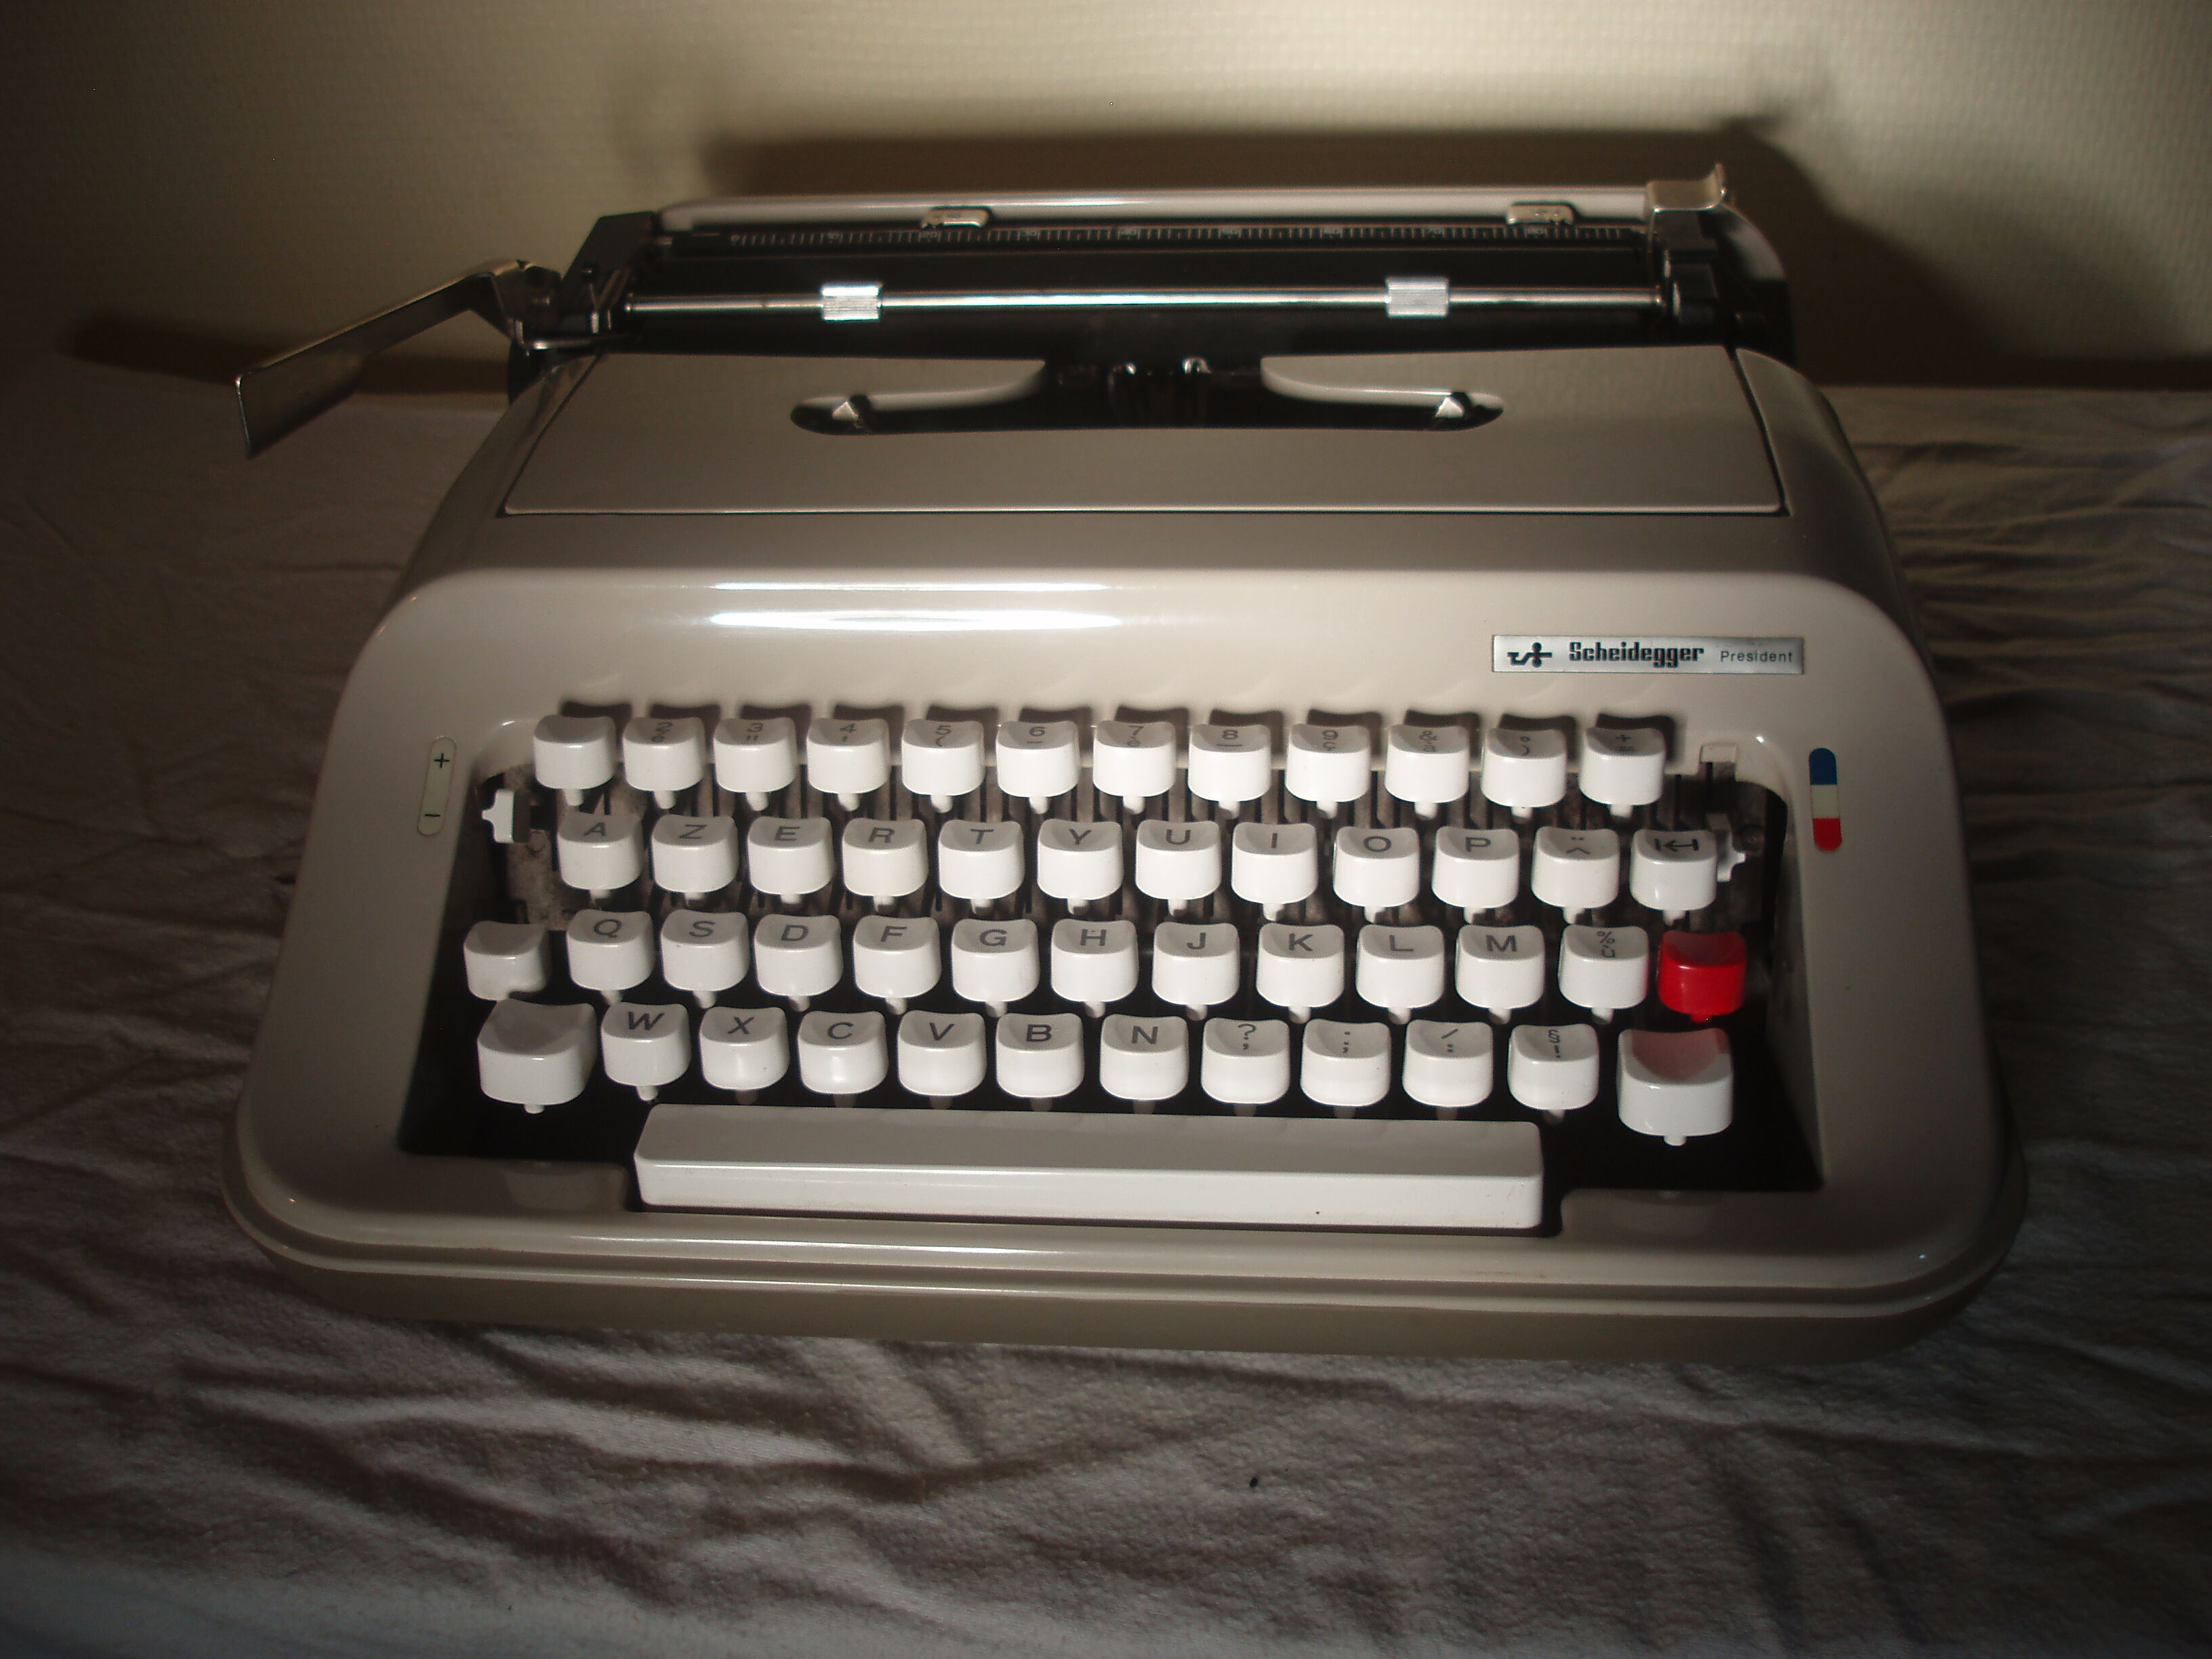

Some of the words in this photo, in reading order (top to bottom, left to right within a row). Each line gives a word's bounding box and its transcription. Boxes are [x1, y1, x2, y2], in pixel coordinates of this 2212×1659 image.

[1569, 642, 1704, 668] Scheidegger
[1720, 651, 1793, 663] President
[655, 722, 672, 731] 2
[747, 723, 763, 733] 3
[840, 724, 857, 733] 4
[935, 725, 951, 735] 5
[1029, 726, 1045, 736] 6
[1129, 726, 1144, 735] 7
[1222, 730, 1237, 740] 8
[1322, 731, 1338, 739] 9
[583, 822, 607, 837] A
[678, 824, 708, 840] Z
[774, 826, 801, 842] E
[868, 827, 895, 843] R
[970, 829, 994, 844] T
[1069, 830, 1093, 845] Y
[1166, 830, 1192, 845] U
[1271, 832, 1279, 848] I
[1363, 836, 1393, 853] O
[1465, 837, 1492, 853] P
[593, 920, 622, 938] Q
[689, 921, 716, 937] S
[780, 925, 808, 942] D
[880, 926, 907, 942] F
[979, 929, 1007, 947] G
[1079, 929, 1107, 946] H
[1187, 933, 1206, 949] J
[1288, 933, 1315, 951] K
[1389, 935, 1414, 951] L
[1486, 935, 1517, 952] M
[627, 1011, 665, 1031] W
[727, 1017, 755, 1034] X
[827, 1022, 855, 1040] C
[929, 1023, 955, 1041] V
[1026, 1025, 1052, 1042] B
[1131, 1026, 1159, 1044] N
[1237, 1023, 1256, 1040] ?
